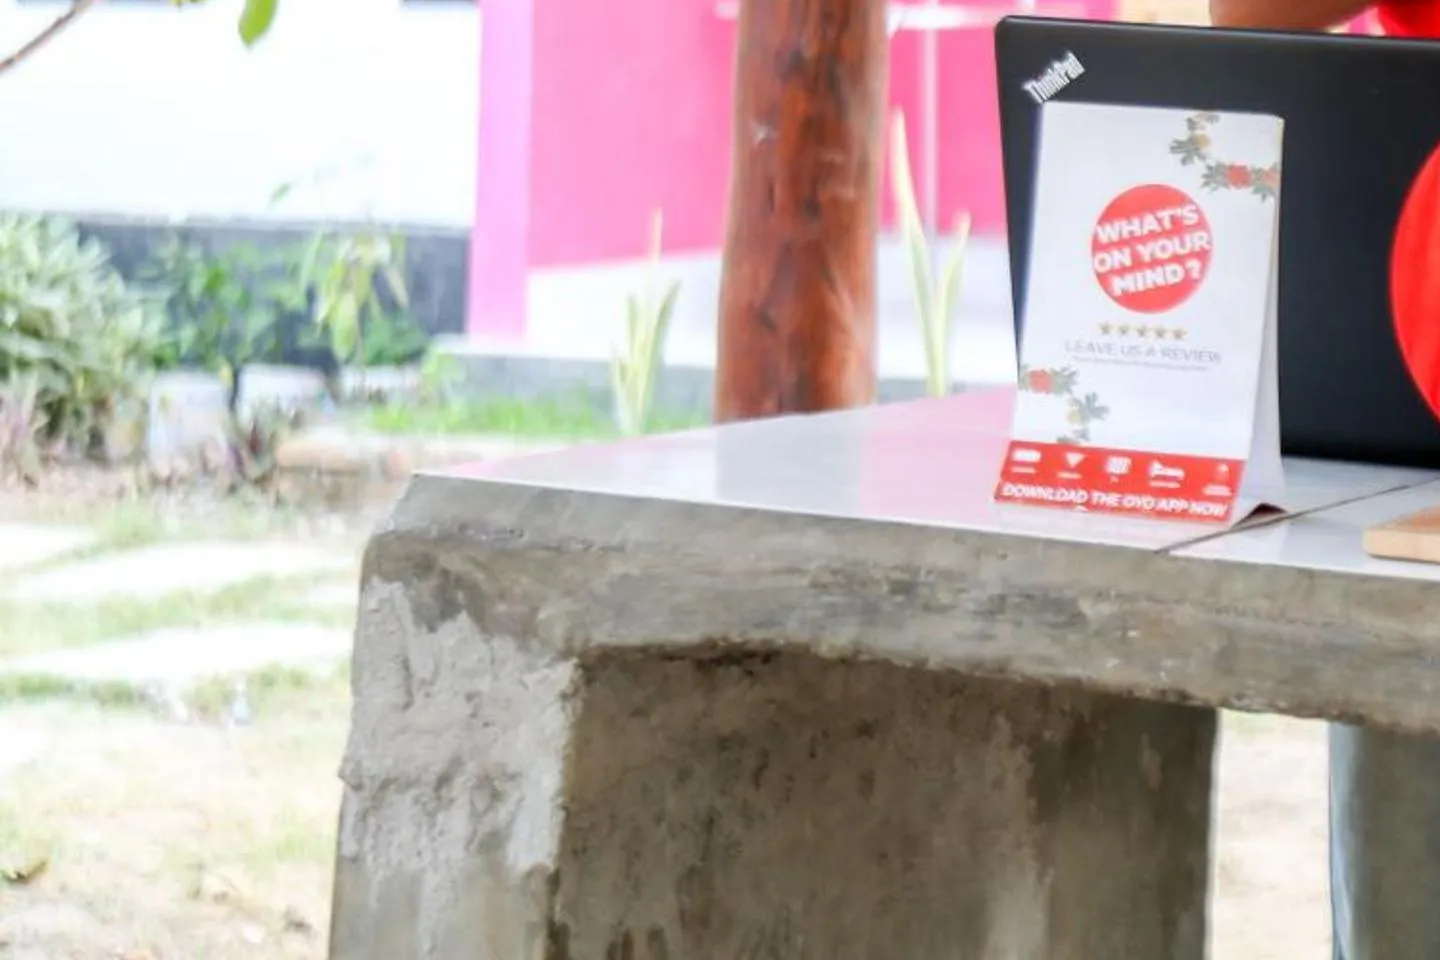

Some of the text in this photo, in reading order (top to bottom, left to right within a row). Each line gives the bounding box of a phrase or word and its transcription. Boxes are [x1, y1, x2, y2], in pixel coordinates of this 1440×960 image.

[1022, 51, 1086, 103] ThinkPad
[1096, 203, 1200, 244] WHAT'S
[1094, 231, 1211, 274] ON YOUR
[1064, 340, 1117, 355] LEAVE
[1120, 343, 1142, 357] US
[1145, 344, 1157, 358] A
[1160, 347, 1223, 365] REVIEW
[1001, 482, 1228, 518] DOWNLOAD THE OYO APP NOW
